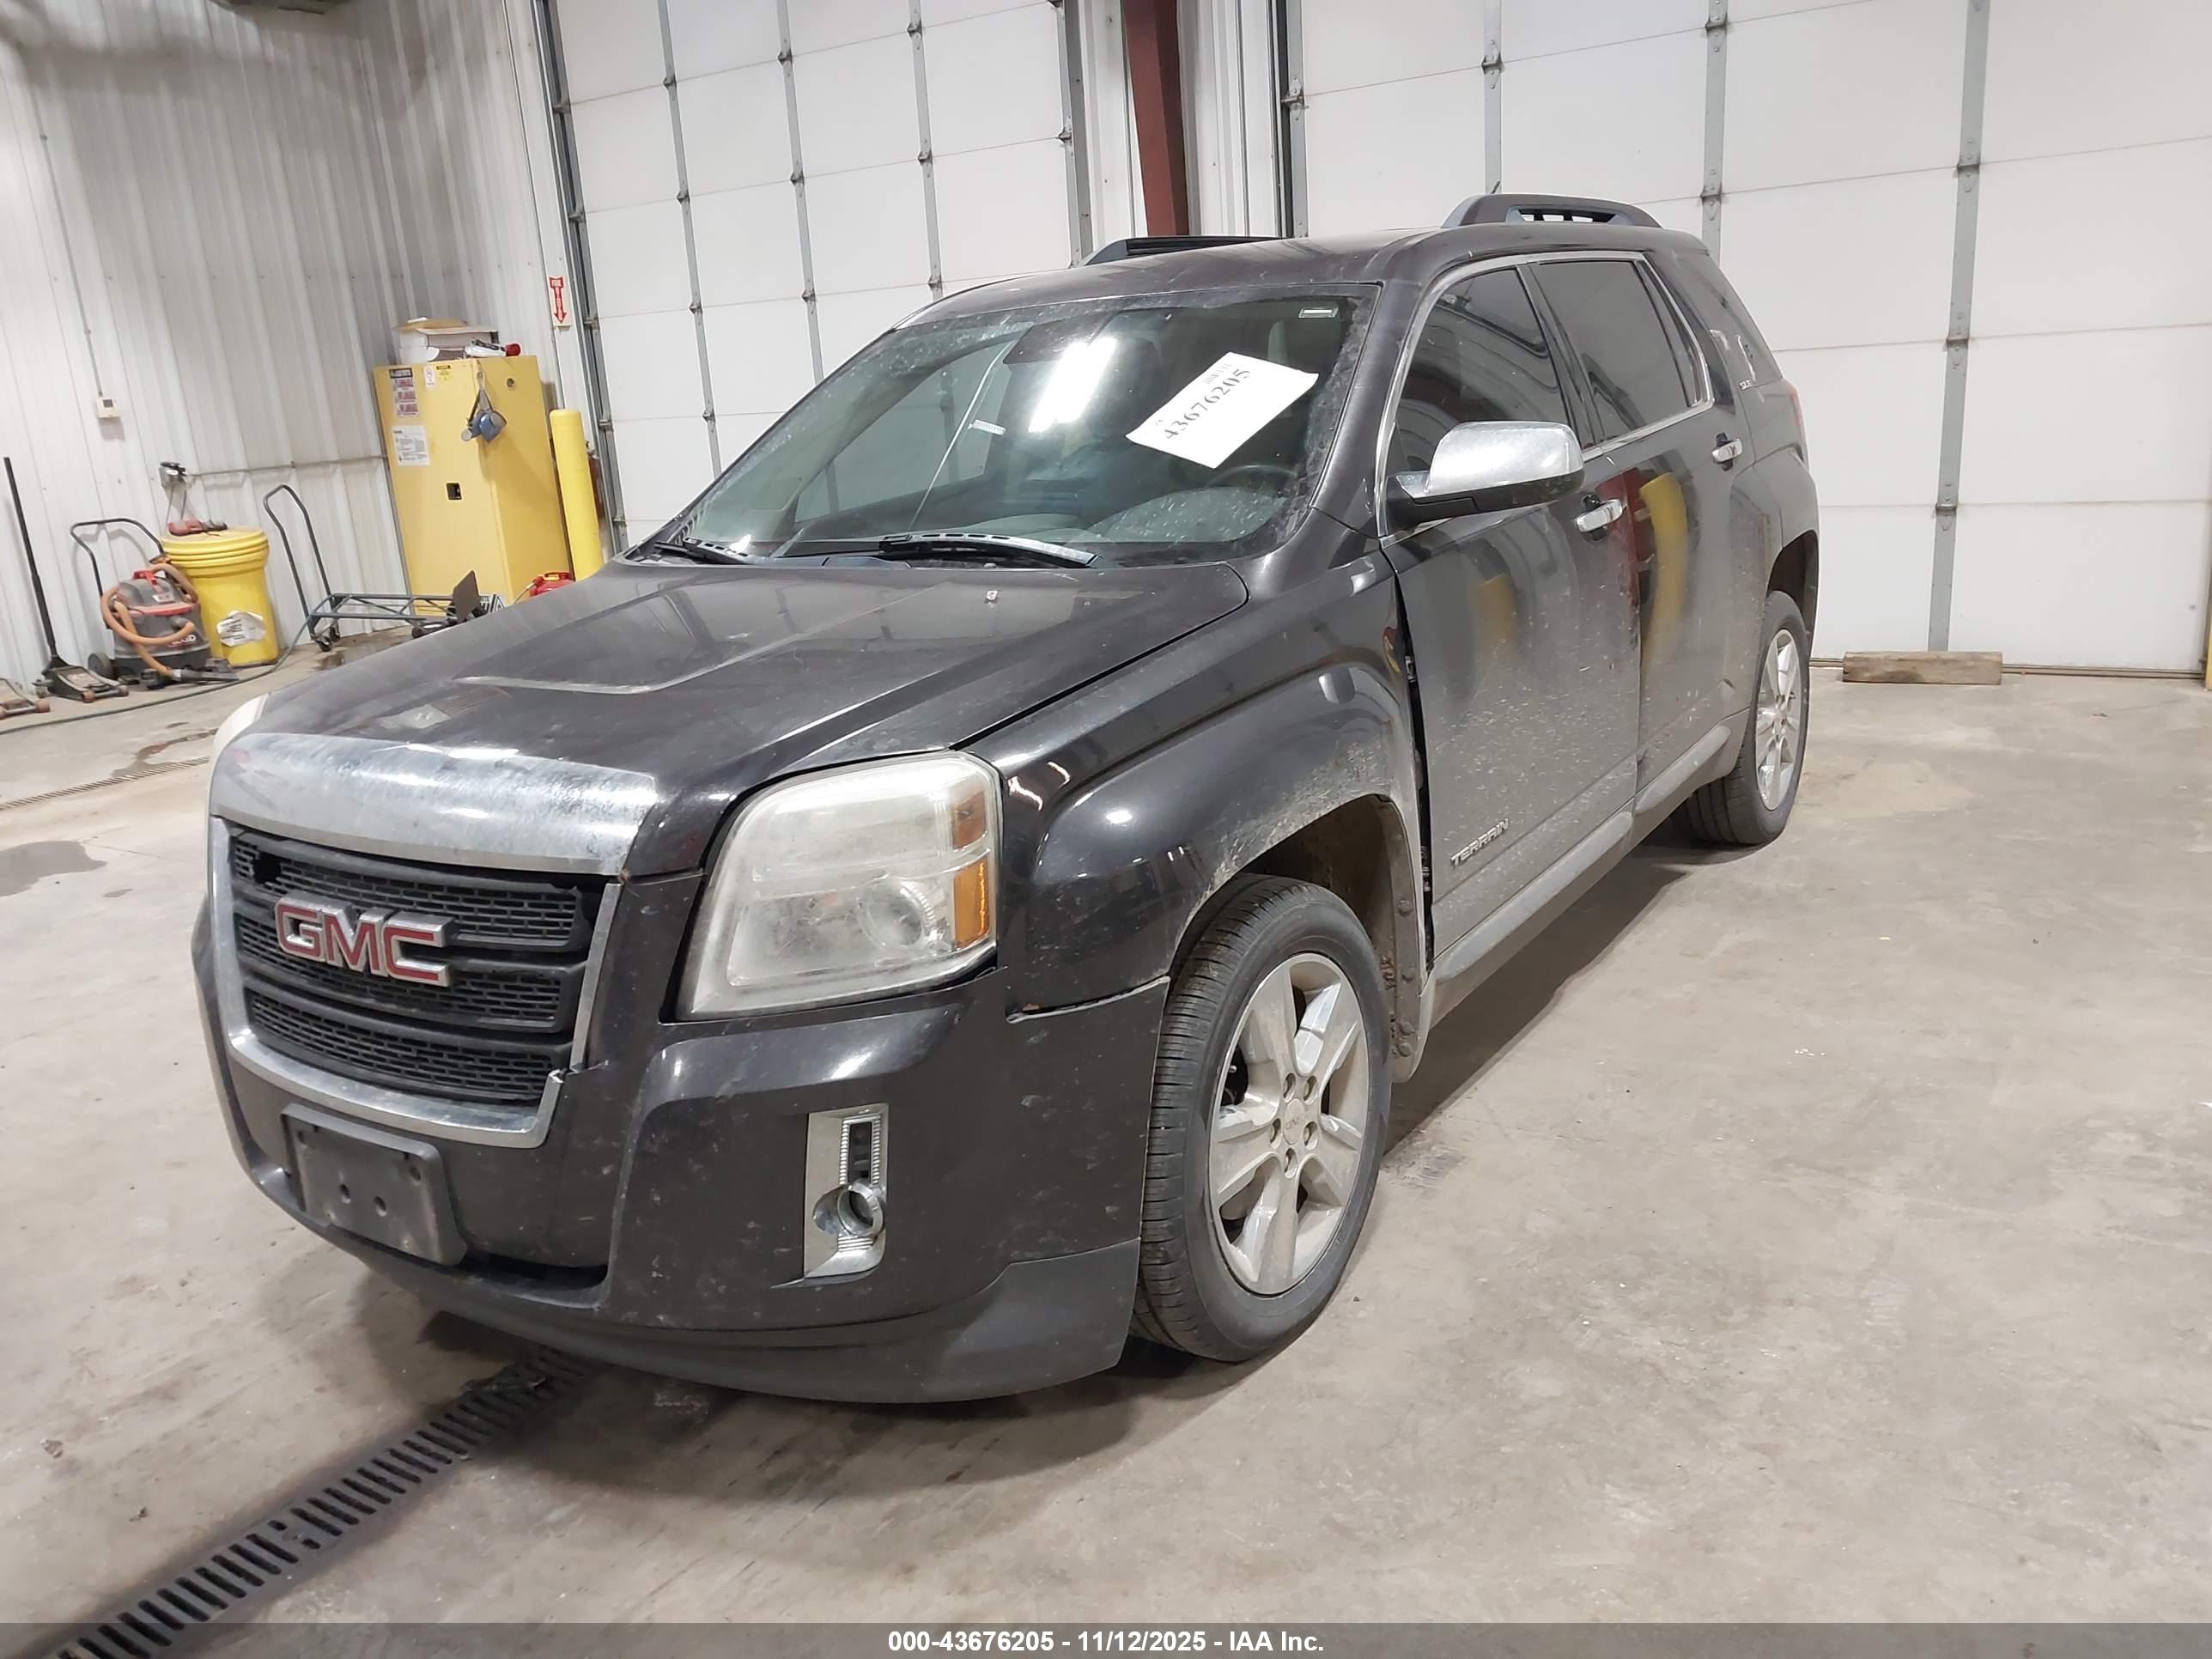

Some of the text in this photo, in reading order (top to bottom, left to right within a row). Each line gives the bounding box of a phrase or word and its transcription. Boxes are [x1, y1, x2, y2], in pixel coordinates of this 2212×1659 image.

[1164, 368, 1251, 440] 43676205
[1450, 817, 1509, 866] TERRAIN
[274, 893, 453, 988] GMC
